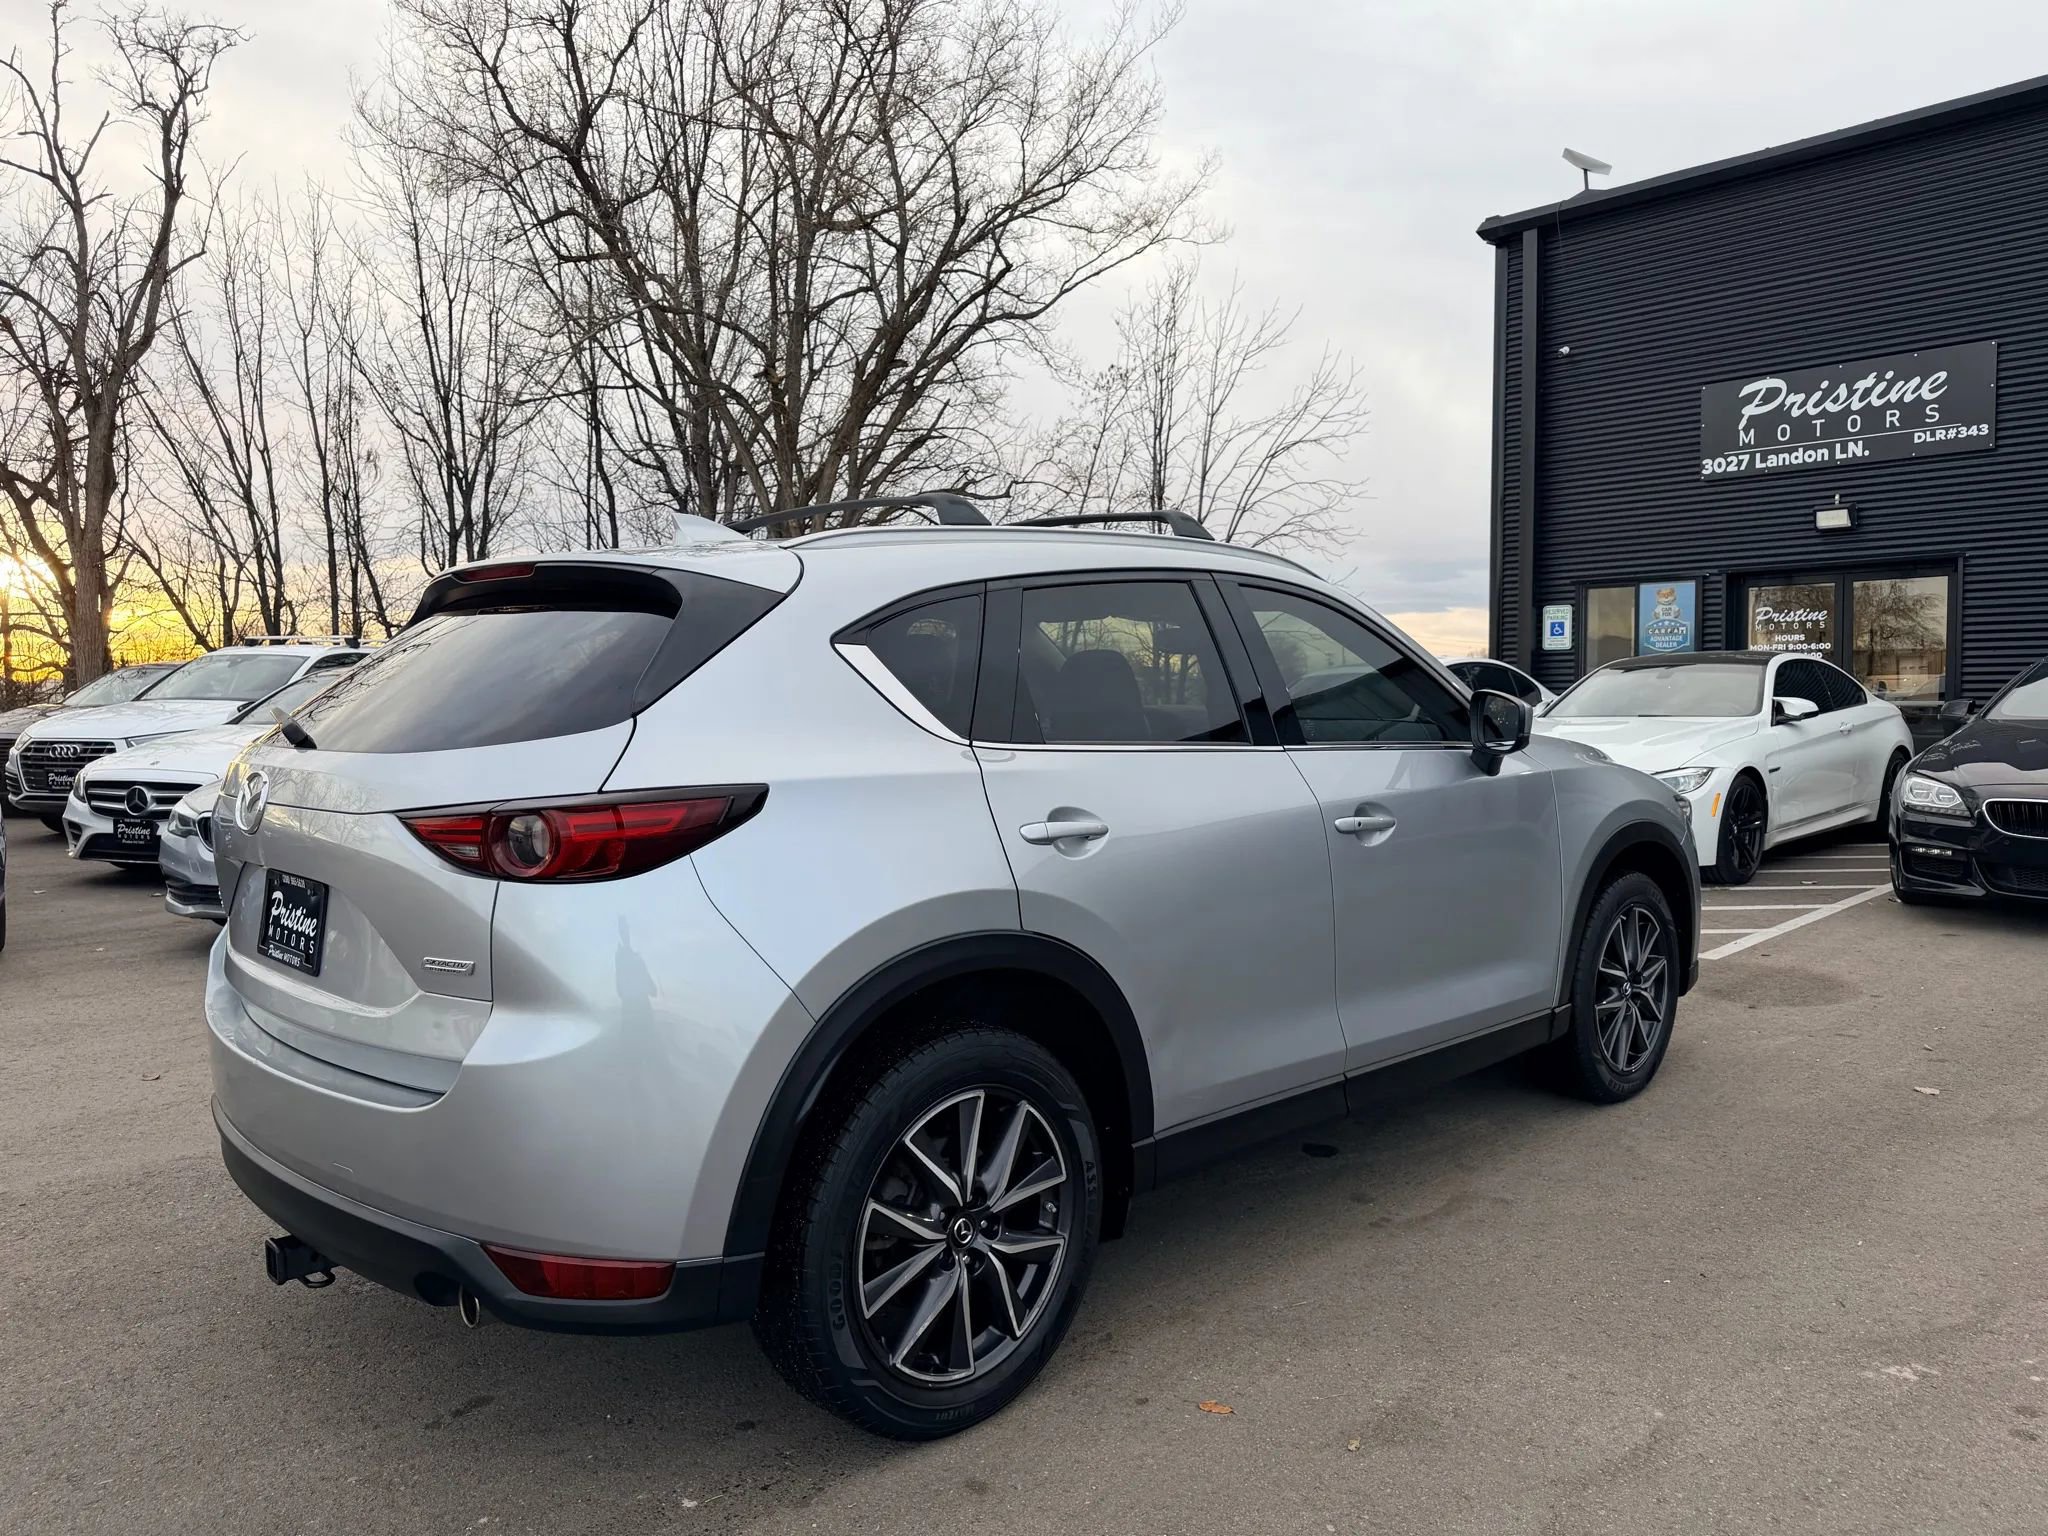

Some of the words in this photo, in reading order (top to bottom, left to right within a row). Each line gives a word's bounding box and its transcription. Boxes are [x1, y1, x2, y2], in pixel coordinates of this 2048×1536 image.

[1738, 370, 1948, 430] Pristine
[1738, 404, 1940, 447] MOTORS
[1913, 423, 1990, 444] DLR#343
[1701, 453, 1750, 475] 3027
[1755, 444, 1829, 469] Landon
[1834, 440, 1870, 460] LN.
[1755, 606, 1828, 626] Pristine
[1755, 621, 1826, 632] MOTORS
[1650, 634, 1684, 642] ADVANTAGE
[1750, 643, 1786, 651] MON-FRI
[1787, 642, 1832, 651] 9:00-6:00
[1775, 633, 1806, 642] HOURS
[117, 823, 151, 836] Pristine
[269, 890, 318, 937] Pristine
[267, 924, 315, 954] MOTORS
[424, 959, 469, 969] SKYACTIV
